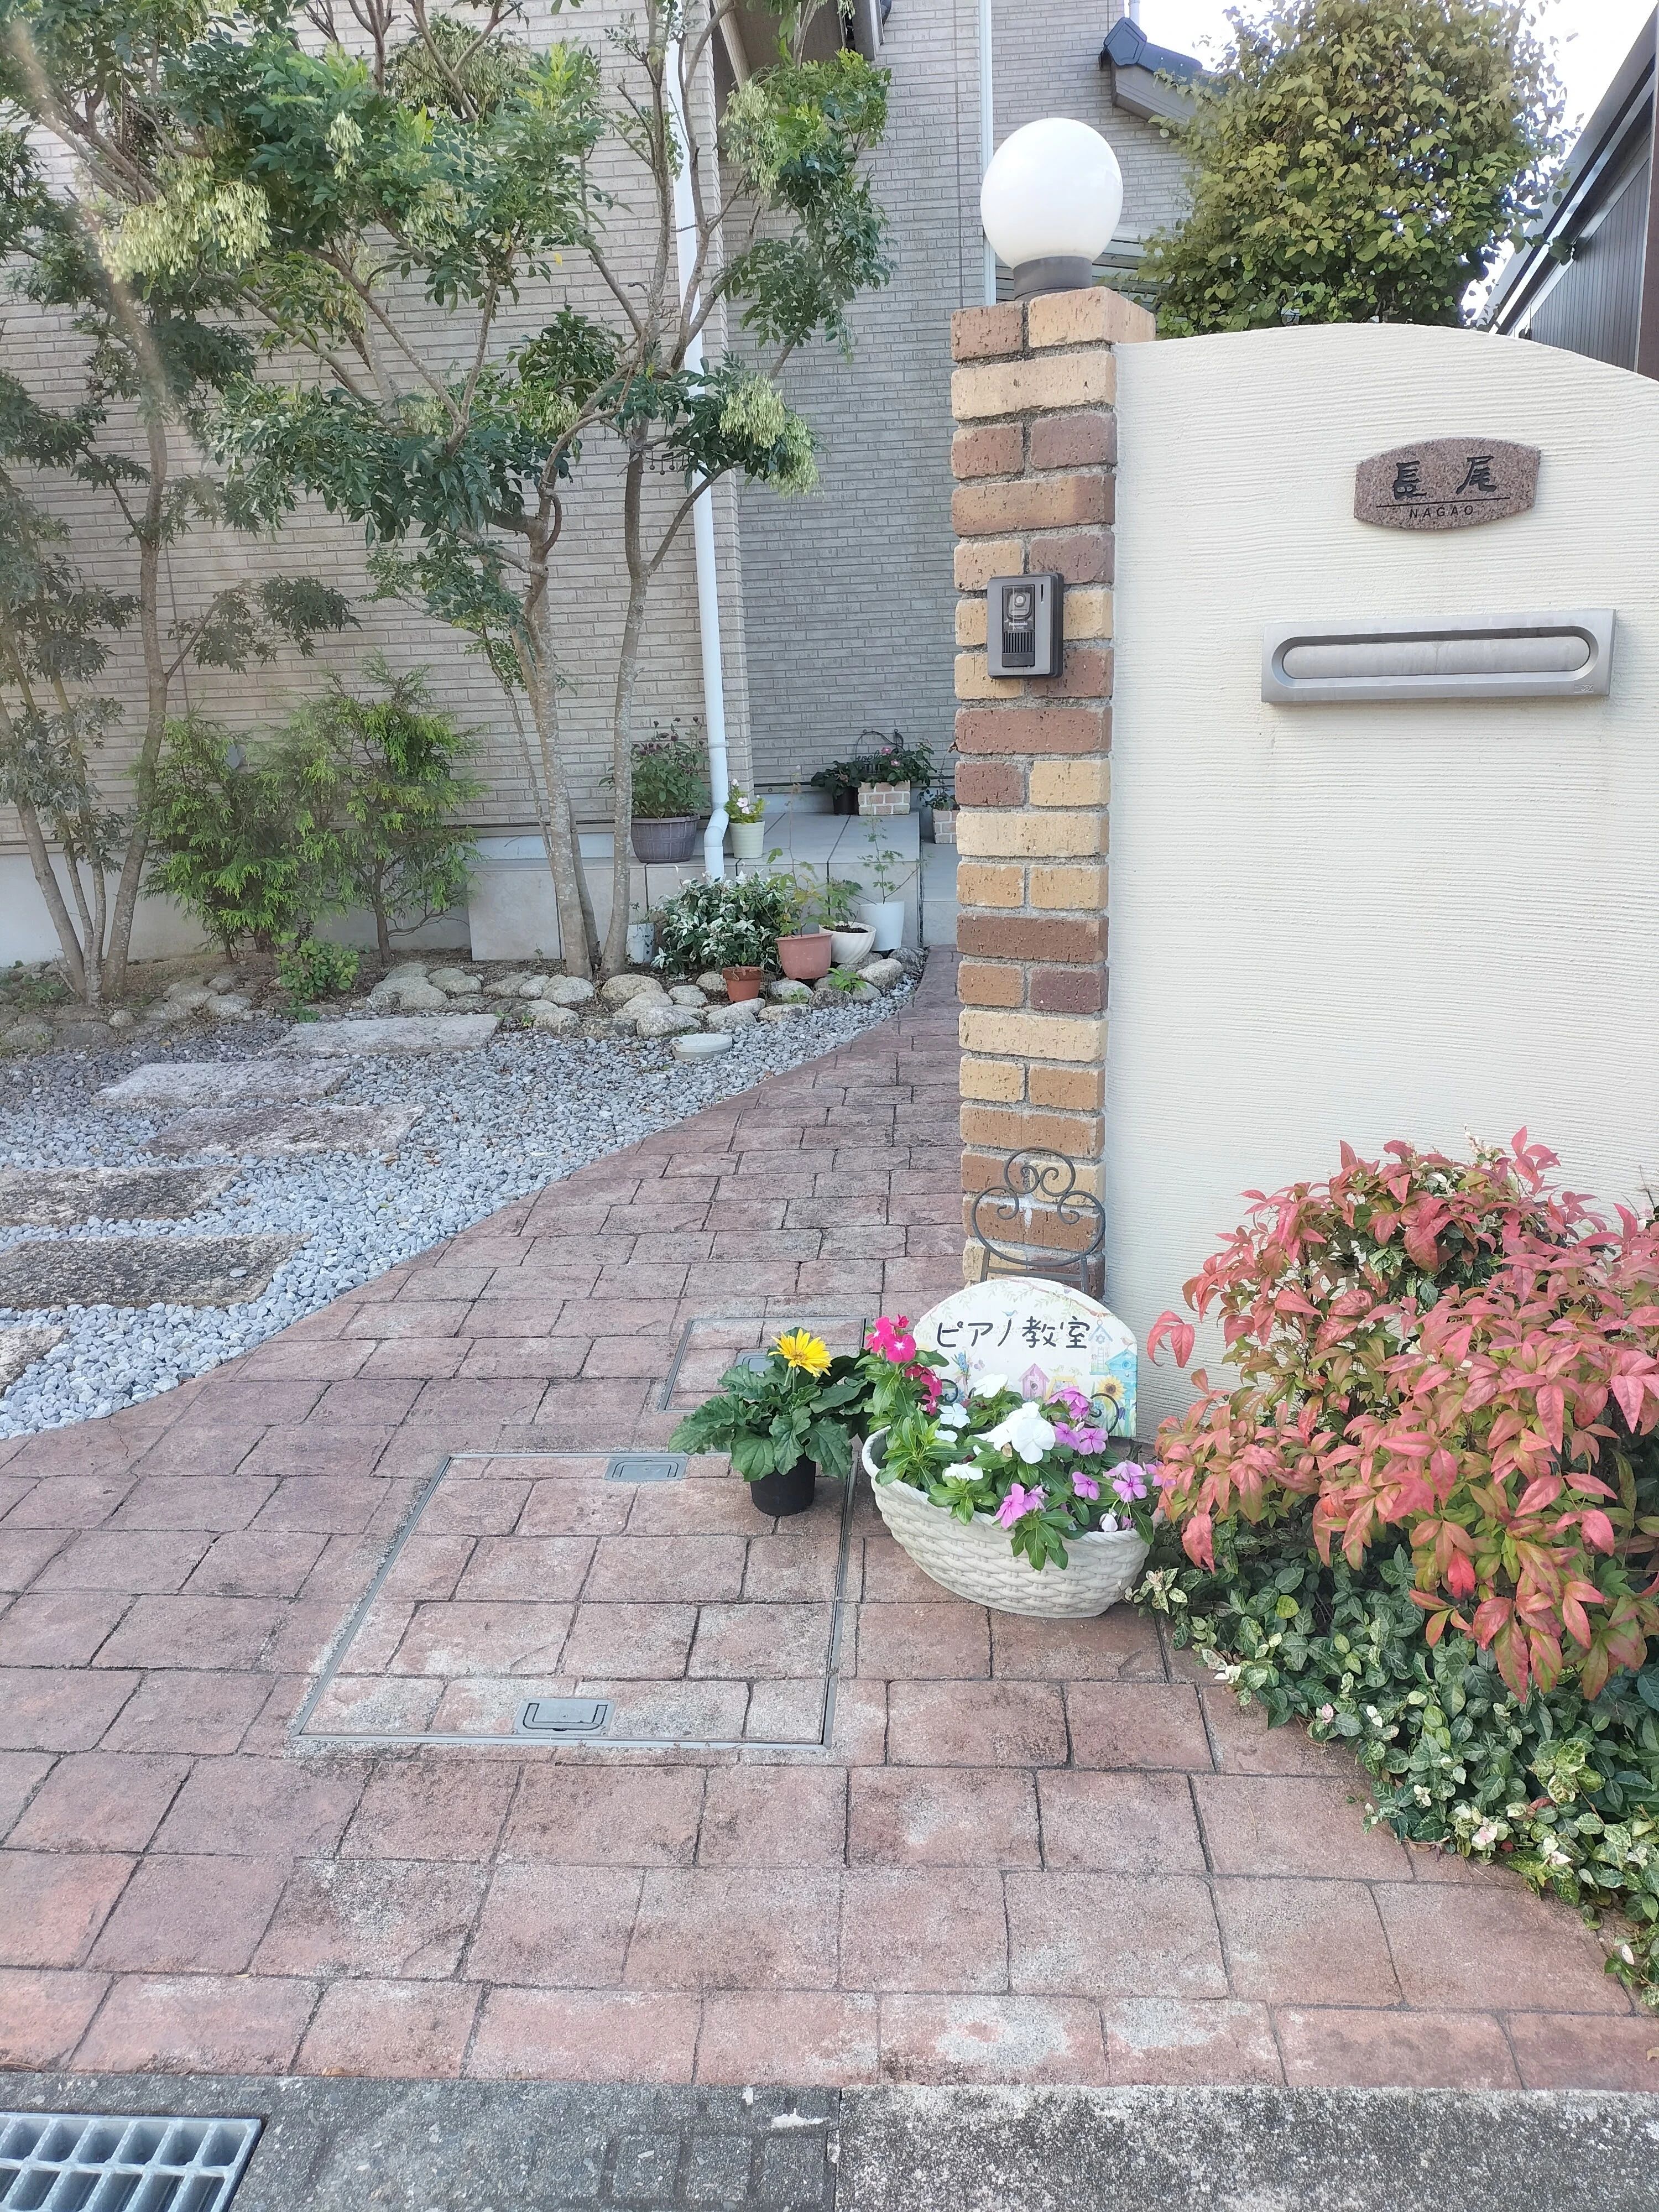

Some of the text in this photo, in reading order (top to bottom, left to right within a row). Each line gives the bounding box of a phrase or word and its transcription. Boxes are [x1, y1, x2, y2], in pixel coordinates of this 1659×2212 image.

[1410, 505, 1474, 519] NAGAO
[937, 1316, 1090, 1349] ピアノ教室
